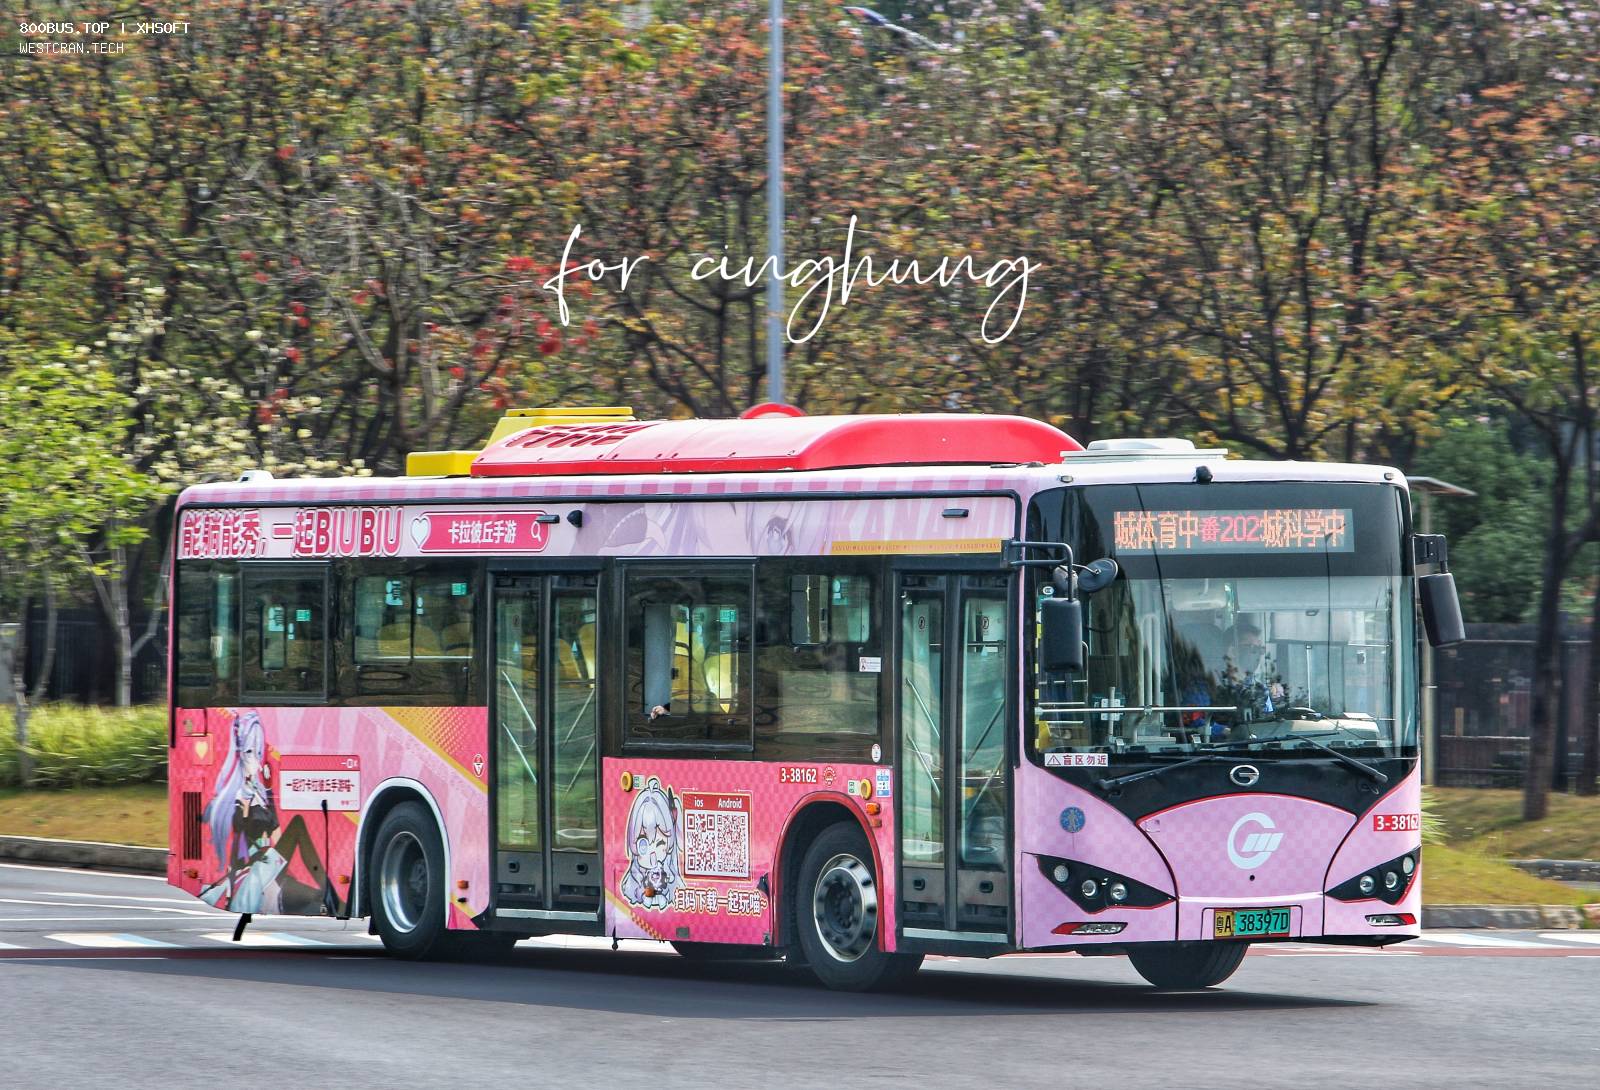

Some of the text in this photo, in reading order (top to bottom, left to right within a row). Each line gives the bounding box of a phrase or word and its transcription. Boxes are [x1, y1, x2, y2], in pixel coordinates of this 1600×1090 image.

[448, 520, 517, 544] 卡拉彼丘手游
[1062, 754, 1107, 766] 盲区勿近
[781, 767, 817, 783] 3-38162
[717, 797, 743, 809] Android
